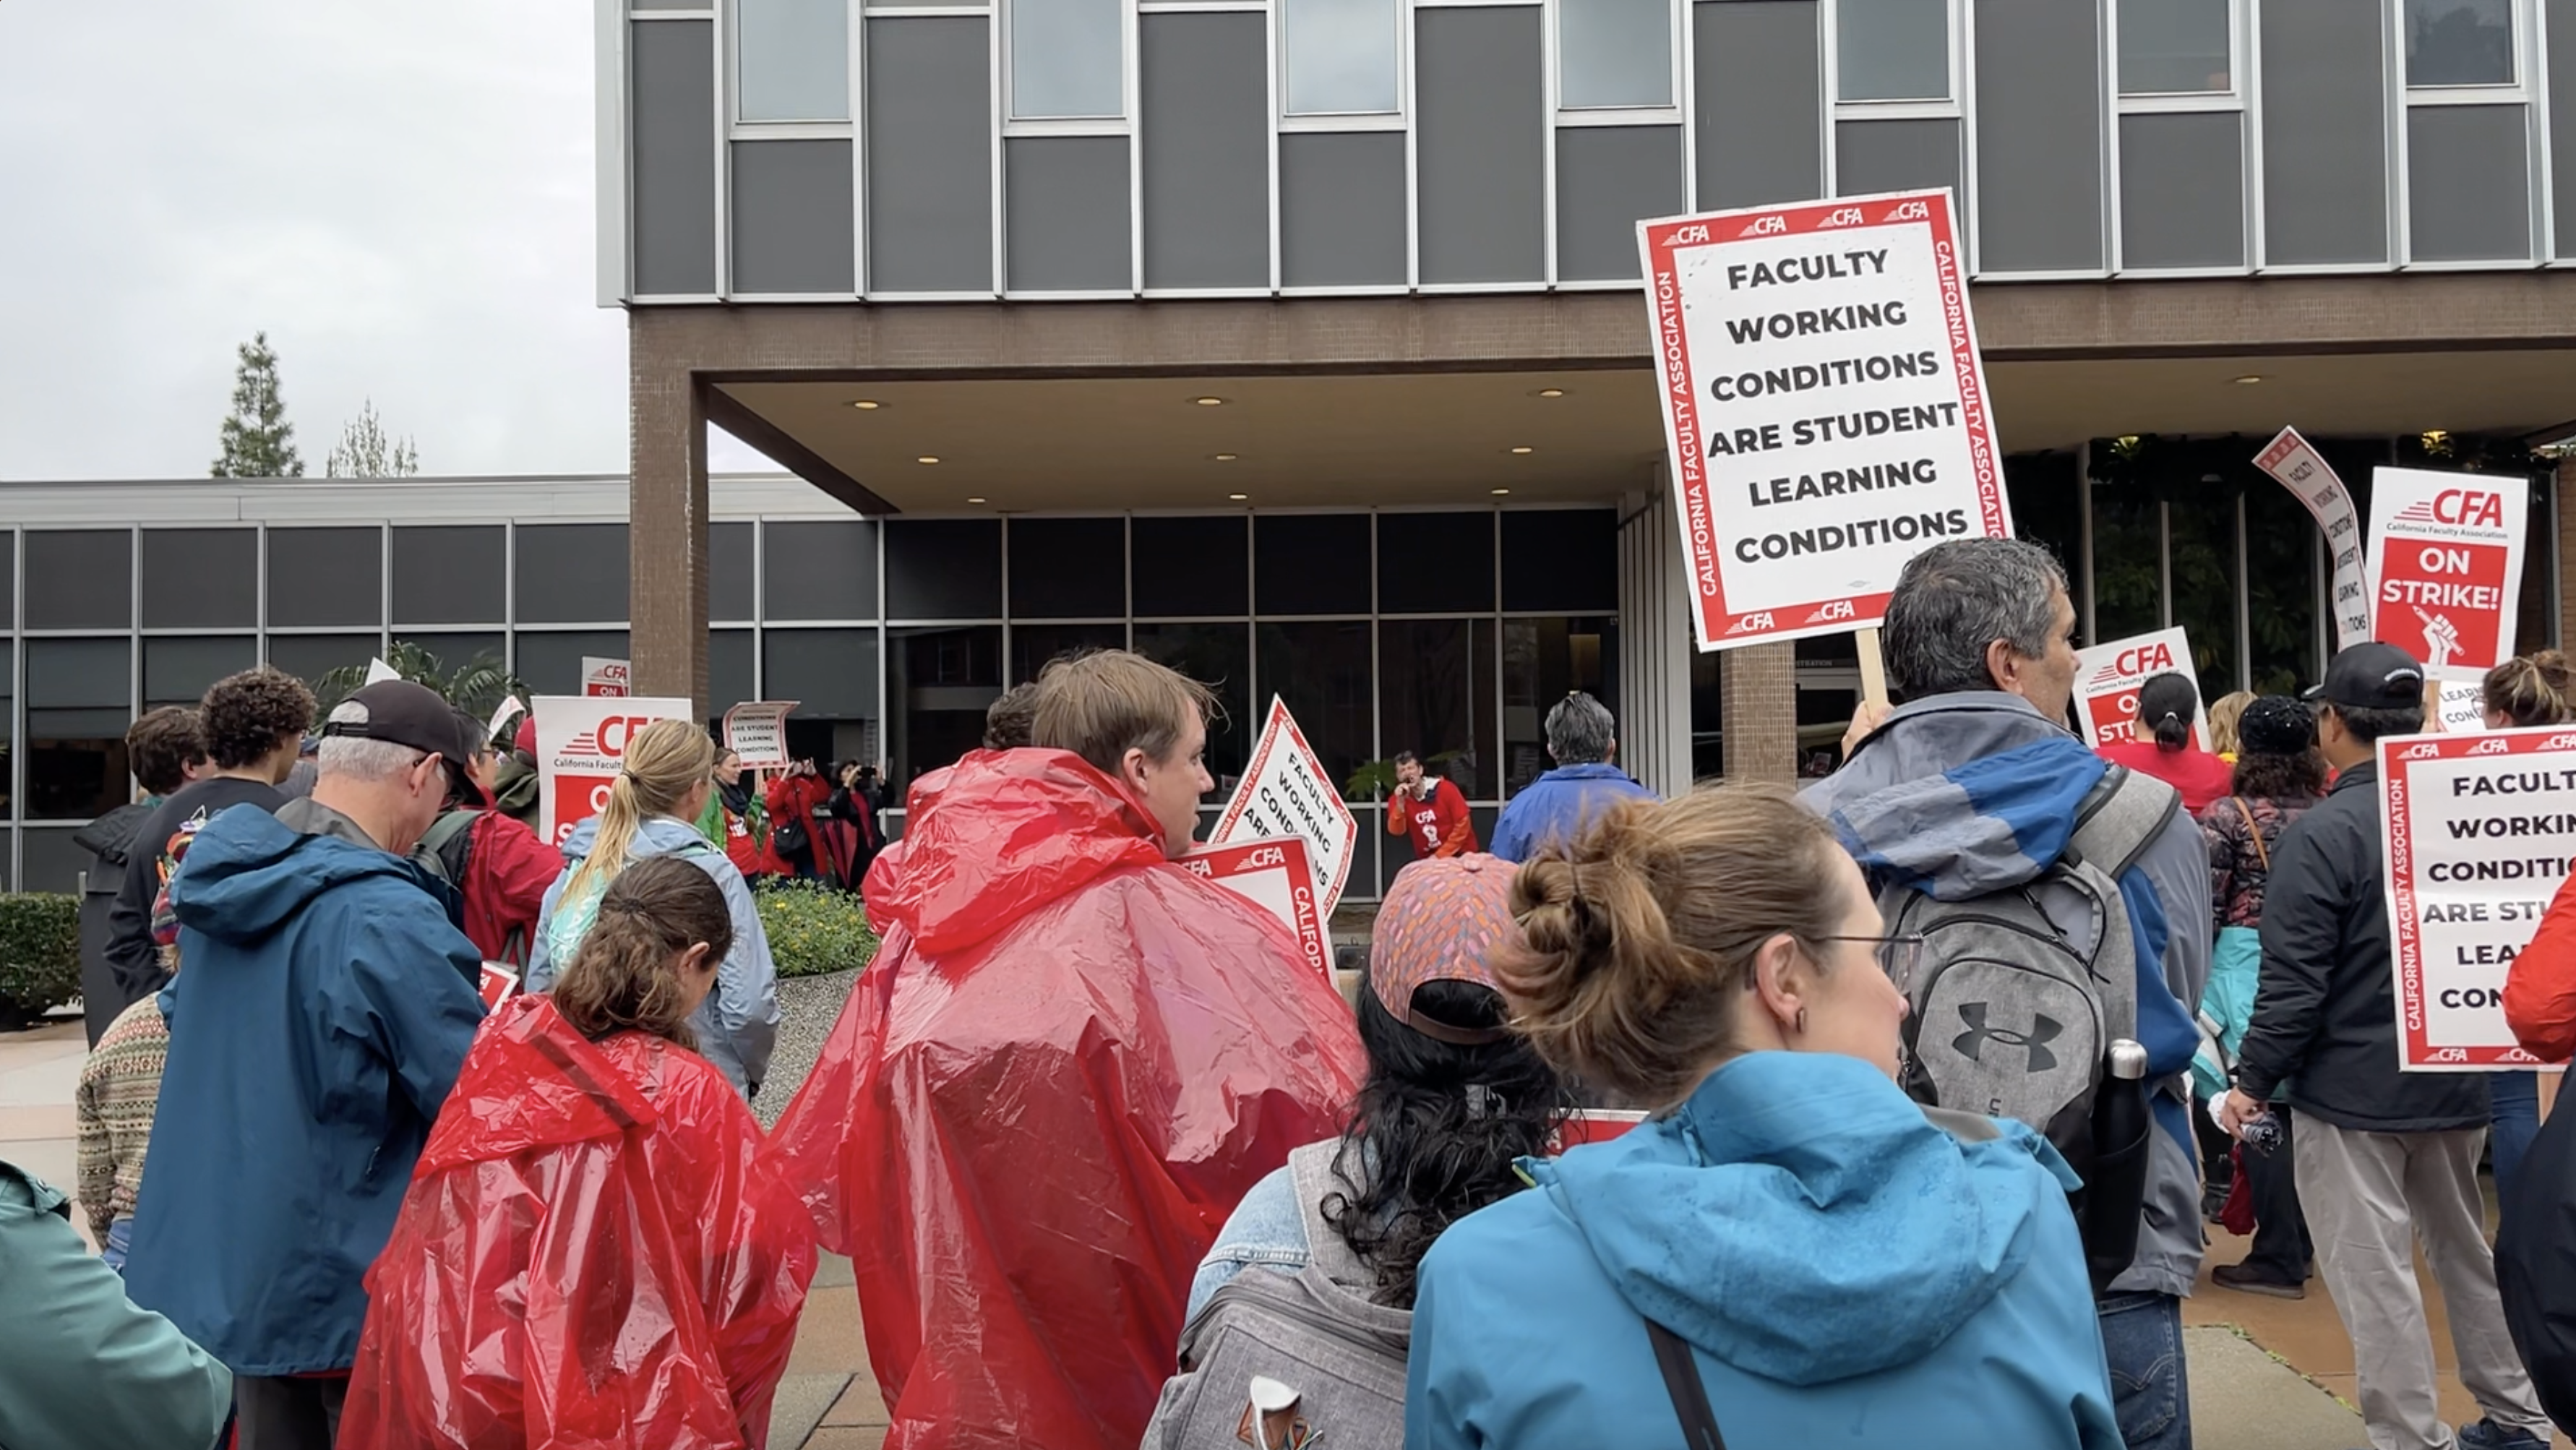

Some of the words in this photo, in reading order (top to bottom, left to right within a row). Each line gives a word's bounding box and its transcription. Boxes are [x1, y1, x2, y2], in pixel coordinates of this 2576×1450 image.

[1677, 225, 1710, 244] CFA
[1753, 215, 1787, 234] CFA
[1831, 207, 1864, 226] CFA
[1897, 201, 1930, 220] CFA
[1727, 249, 1888, 291] FACULTY
[1657, 272, 1688, 395] ASSOCIATION
[1725, 301, 1907, 345] WORKING
[1936, 240, 1967, 350] CALIFORNIA
[1956, 352, 1984, 432] FACULTY
[1710, 351, 1939, 402] CONDITIONS
[1674, 400, 1701, 479] FACULTY
[1707, 424, 1783, 458] ARE
[1791, 401, 1959, 446] STUDENT
[1748, 458, 1937, 507] LEARNING
[2432, 488, 2503, 528] CFA
[1687, 484, 1717, 596] CALIFORNIA
[1735, 509, 1968, 564] CONDITIONS
[2387, 522, 2426, 533] California
[2429, 525, 2458, 537] Faculty
[2460, 528, 2508, 539] Association
[2418, 547, 2470, 575] ON
[1740, 612, 1774, 631] CFA
[1820, 600, 1855, 620] CFA
[2382, 579, 2499, 610] STRIKE!
[604, 664, 627, 679] CFA
[2116, 643, 2174, 677] CFA
[599, 687, 617, 697] ON
[554, 758, 594, 768] California
[2410, 743, 2439, 758] CFA
[2478, 739, 2509, 753] CFA
[1288, 751, 1335, 825] FACULTY
[2452, 770, 2576, 797] FACULT
[1278, 771, 1332, 854] WORKING
[1415, 809, 1437, 824] CFA
[2390, 778, 2408, 875] ASSOCIATION
[1250, 846, 1286, 867] CFA
[1295, 886, 1324, 974] CALIFOR
[2396, 878, 2415, 940] FACULTY
[2422, 903, 2489, 923] ARE
[2402, 942, 2421, 1031] CALIFORNIA
[2438, 1048, 2468, 1062] CFA
